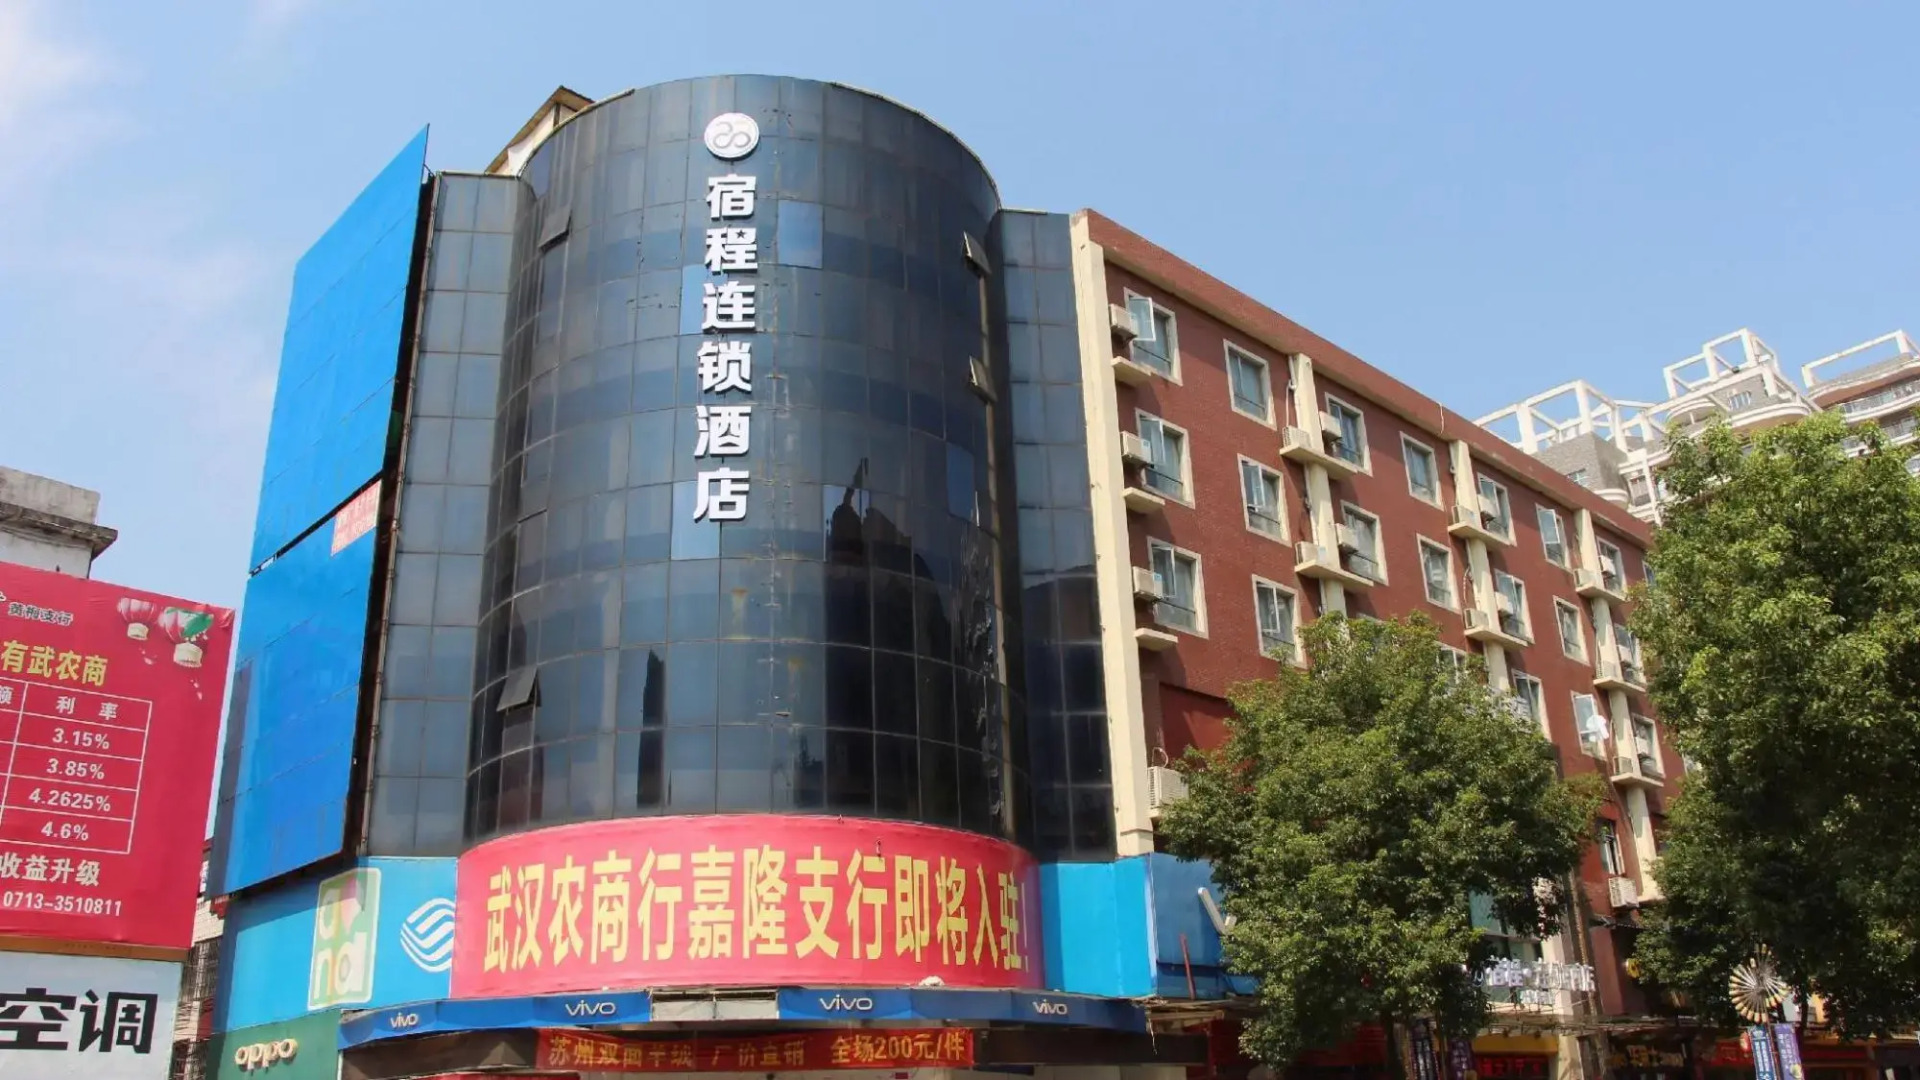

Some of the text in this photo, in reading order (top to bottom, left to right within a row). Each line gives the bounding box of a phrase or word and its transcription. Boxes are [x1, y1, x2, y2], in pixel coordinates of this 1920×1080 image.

[693, 173, 758, 523] 宿程连锁酒店
[0, 640, 108, 687] 有武农商
[52, 727, 110, 750] 3.15%
[46, 758, 105, 780] 3.85%
[28, 787, 111, 812] 4.2625%
[41, 821, 89, 841] 4.6%
[0, 852, 101, 887] 收益升级
[3, 890, 123, 917] 0713-3510811
[565, 1000, 616, 1016] vivo
[819, 994, 873, 1011] vivo
[1032, 998, 1068, 1015] vivo
[0, 987, 158, 1054] 空调
[390, 1012, 419, 1029] vivo
[234, 1038, 298, 1072] oppo
